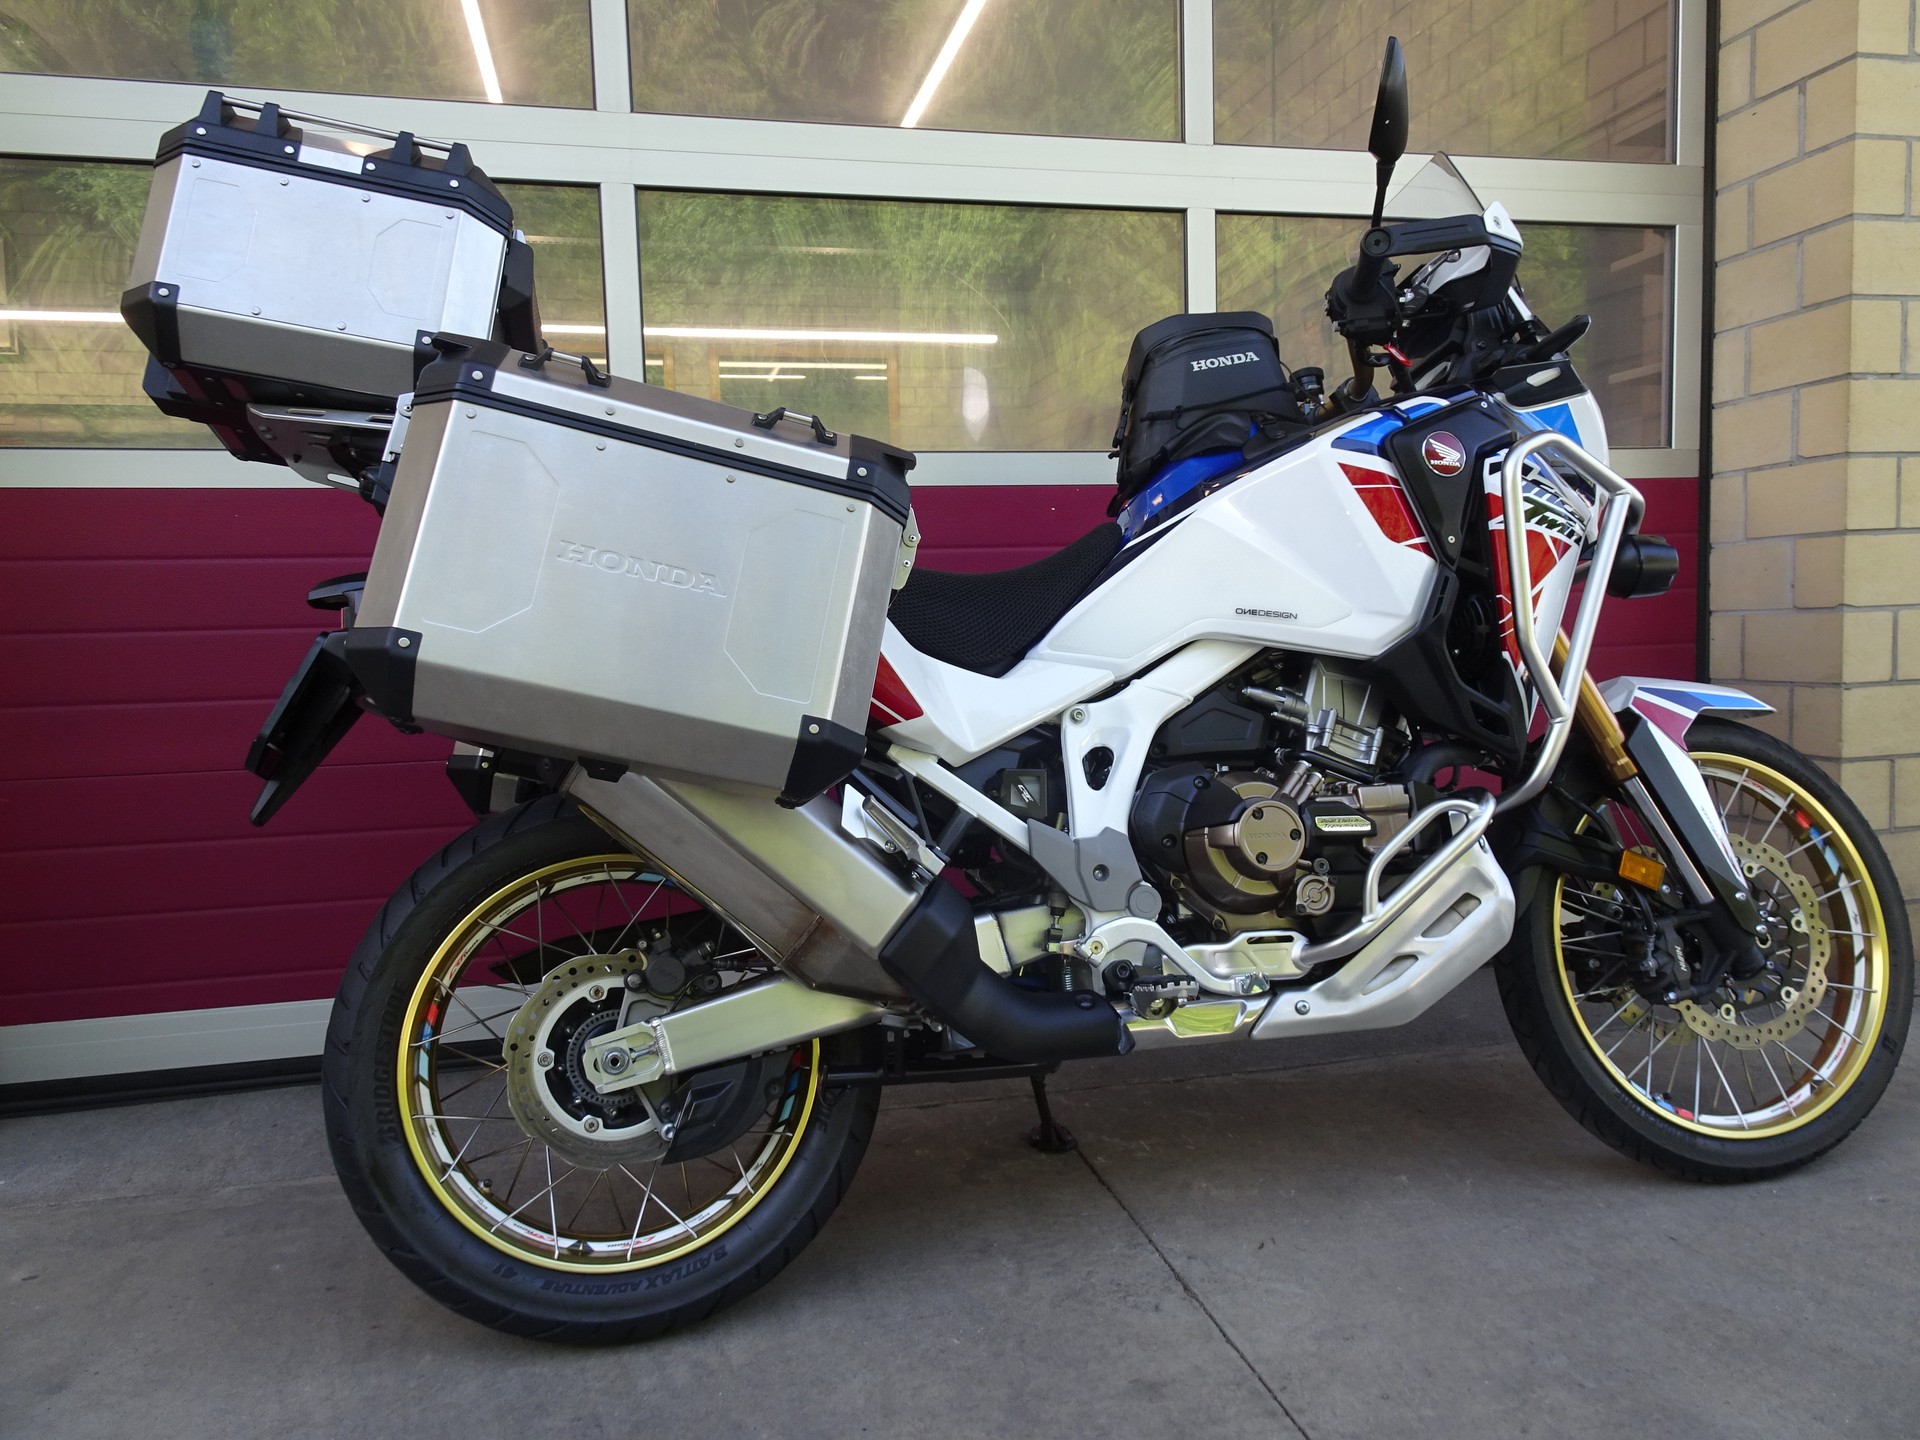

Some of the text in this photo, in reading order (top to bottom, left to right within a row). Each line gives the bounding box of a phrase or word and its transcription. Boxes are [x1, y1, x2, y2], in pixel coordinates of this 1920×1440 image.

[1190, 351, 1260, 372] HONDA
[1430, 459, 1461, 468] HONDA
[556, 539, 727, 598] HONDA
[1235, 607, 1298, 620] ONEDESIGN
[373, 977, 406, 1146] BRIDGESTONE
[644, 1245, 729, 1291] BATTLAX
[540, 1278, 643, 1296] ADVENTURE
